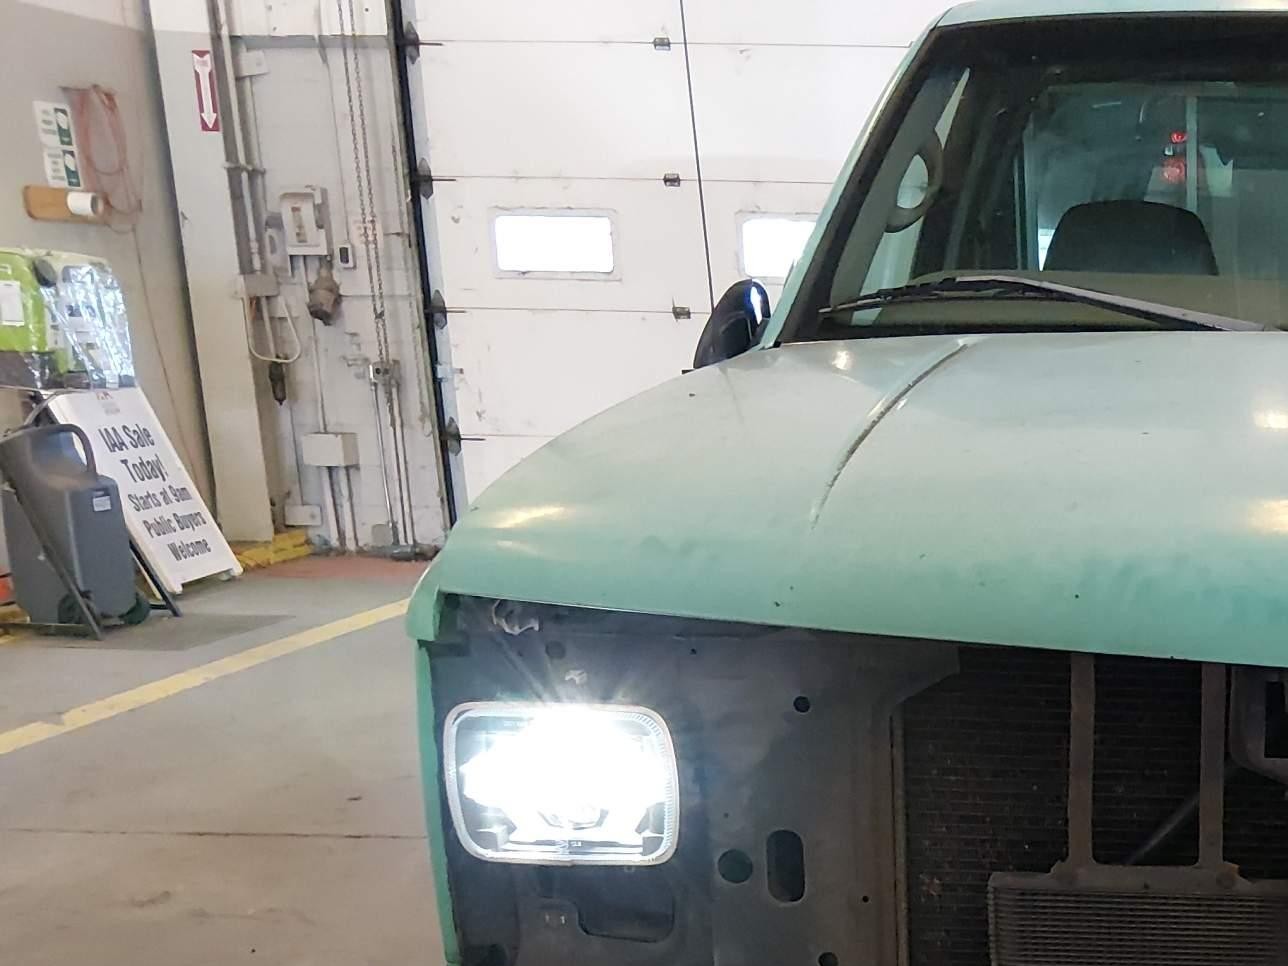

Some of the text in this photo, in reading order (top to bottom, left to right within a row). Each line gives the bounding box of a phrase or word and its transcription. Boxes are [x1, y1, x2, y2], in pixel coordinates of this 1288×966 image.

[98, 424, 155, 453] IAA Sale
[120, 454, 168, 483] Today!
[128, 490, 162, 512] Starts
[160, 488, 173, 507] at
[168, 485, 193, 503] 9am
[142, 511, 207, 538] Public Buyers
[167, 537, 212, 561] Welcome
